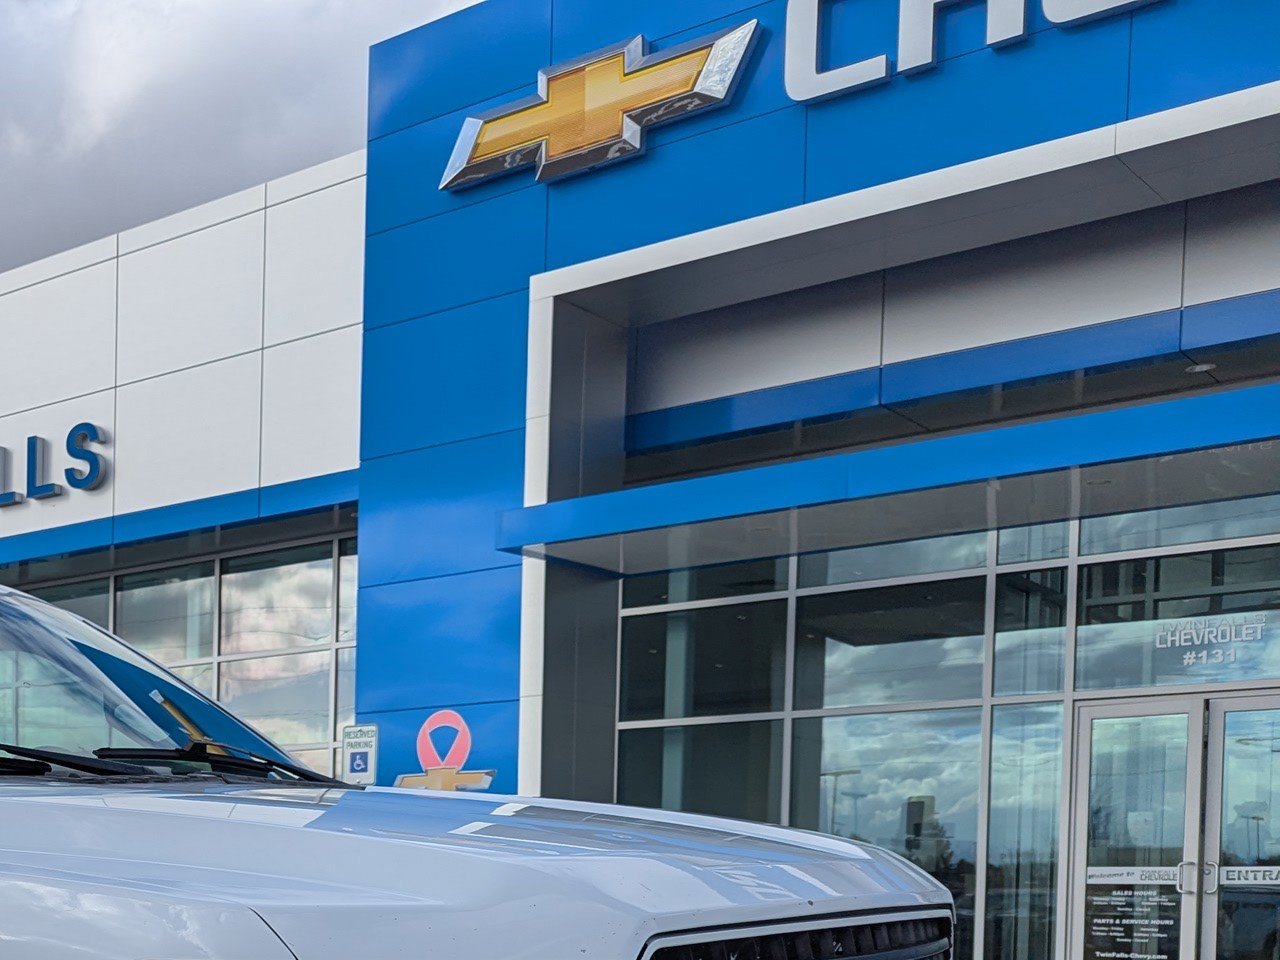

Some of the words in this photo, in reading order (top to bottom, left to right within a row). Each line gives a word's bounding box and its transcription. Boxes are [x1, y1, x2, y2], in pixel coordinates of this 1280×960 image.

[1155, 623, 1266, 649] CHEVROLET
[1183, 647, 1236, 666] #131
[344, 730, 375, 739] RESERVED
[346, 741, 373, 750] PARKING
